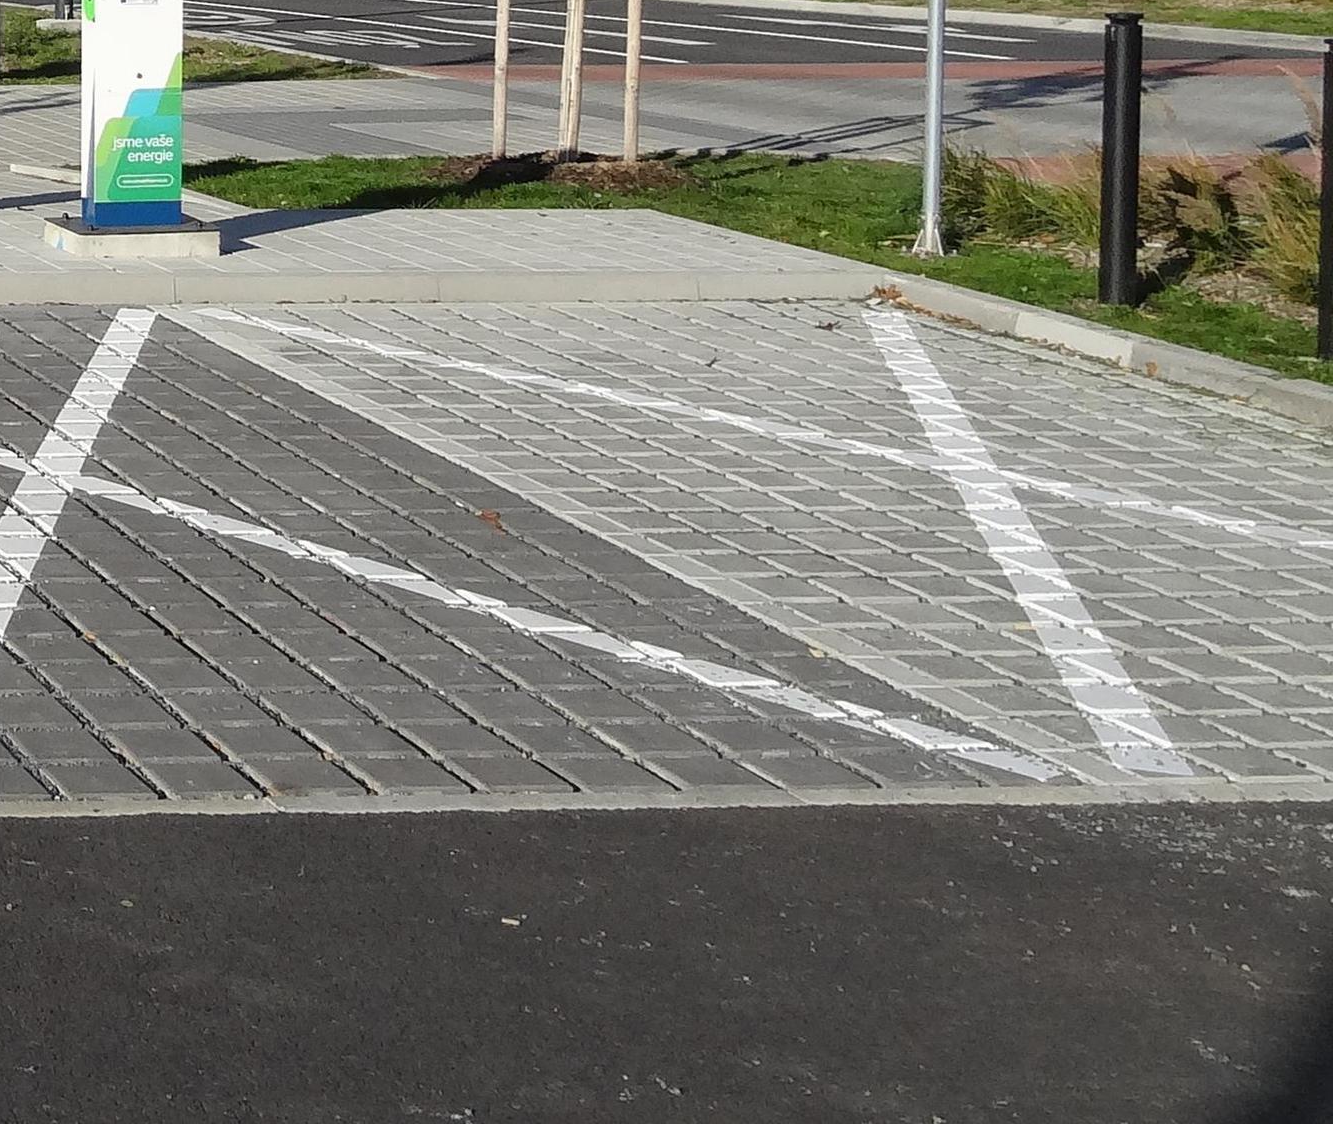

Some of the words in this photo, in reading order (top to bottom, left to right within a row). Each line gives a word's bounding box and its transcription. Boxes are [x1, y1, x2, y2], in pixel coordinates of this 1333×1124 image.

[112, 137, 143, 152] jsme
[145, 133, 174, 147] vaše
[127, 150, 174, 164] energie
